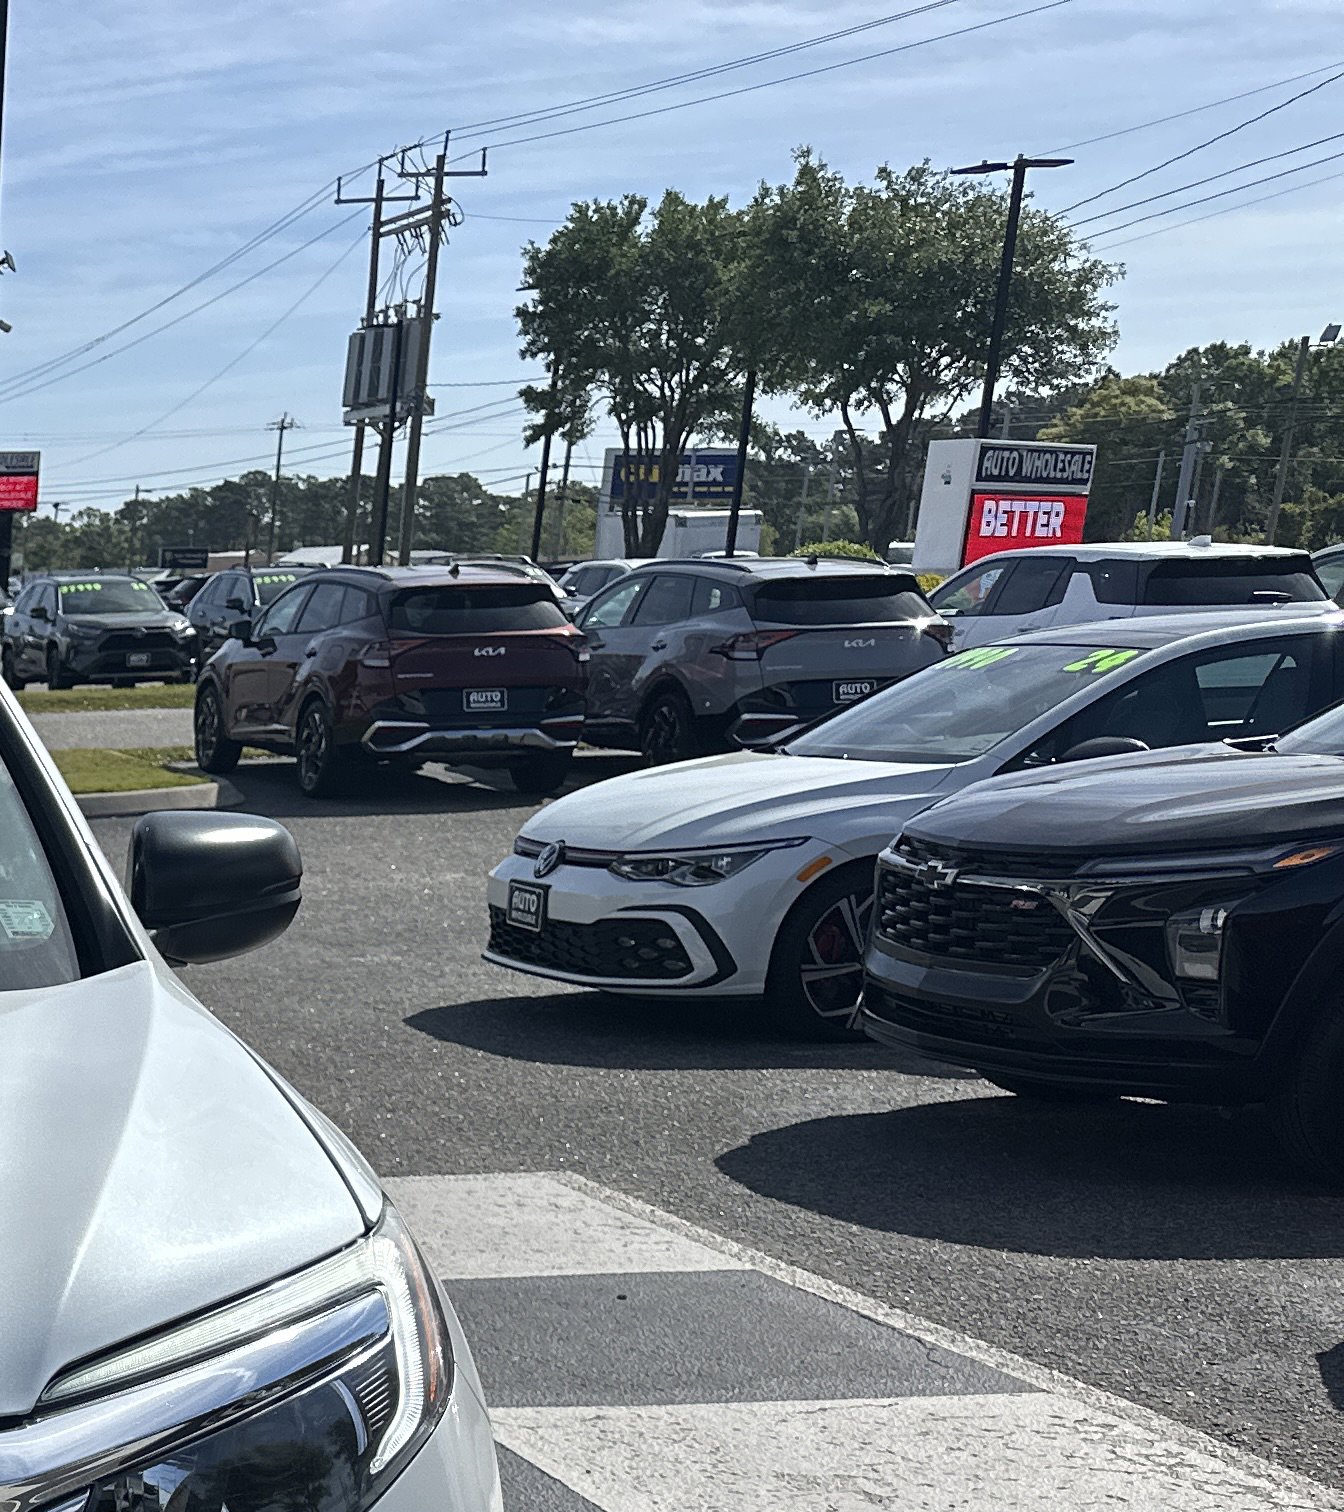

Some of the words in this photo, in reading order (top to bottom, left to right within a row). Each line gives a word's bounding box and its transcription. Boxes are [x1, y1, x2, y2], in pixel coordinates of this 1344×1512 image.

[981, 449, 1020, 478] AUTO
[1021, 450, 1092, 480] WHOLESALE
[979, 500, 1065, 537] BETTER
[1062, 650, 1139, 673] 24
[469, 691, 502, 703] AUTO
[838, 683, 871, 694] AUTO
[512, 890, 538, 912] AUTO
